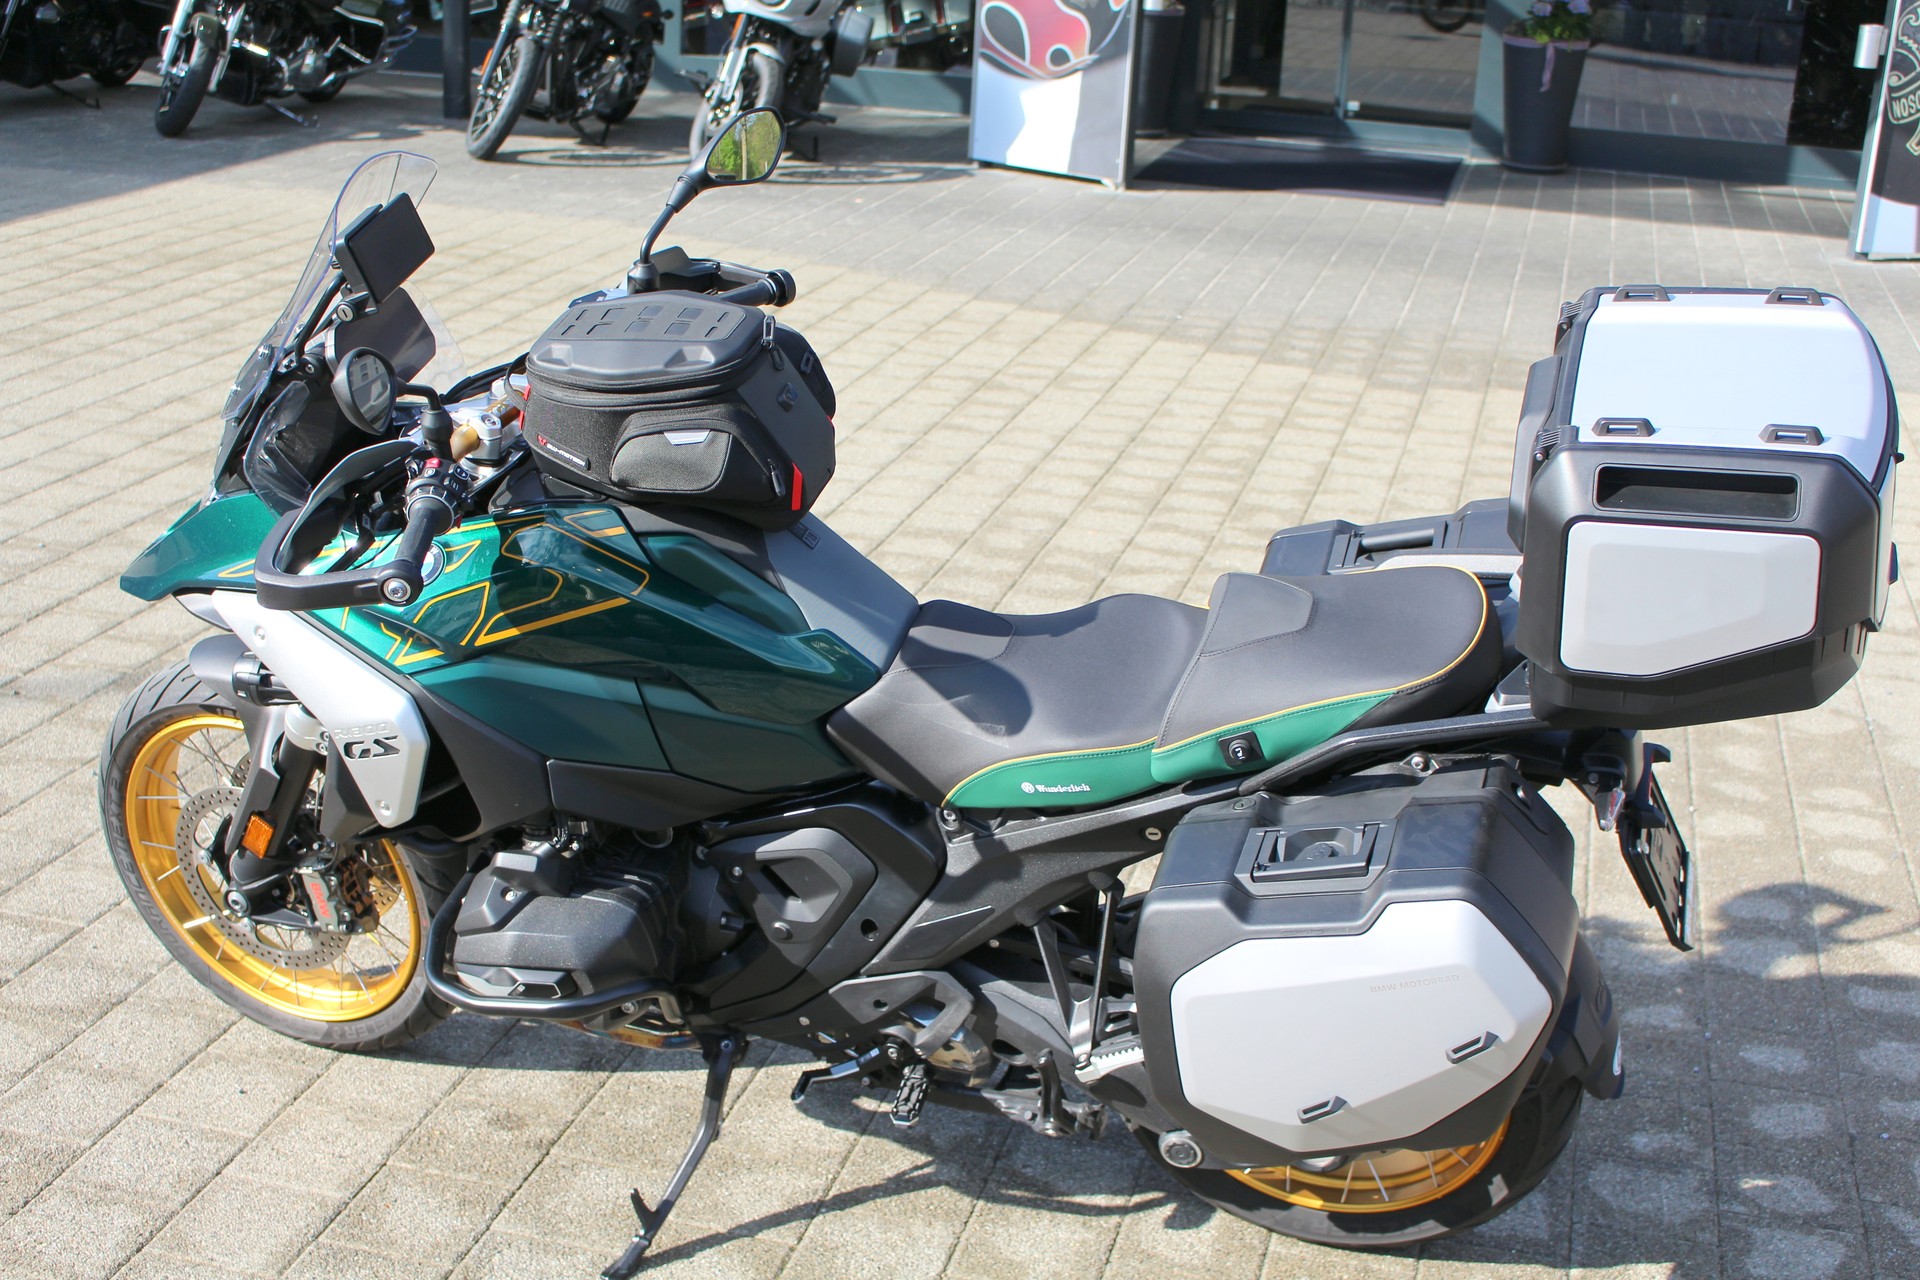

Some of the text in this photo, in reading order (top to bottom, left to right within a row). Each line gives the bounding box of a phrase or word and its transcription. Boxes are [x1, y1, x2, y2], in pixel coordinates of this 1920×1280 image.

[343, 735, 401, 760] GS
[1035, 783, 1091, 793] Wunderlich
[310, 882, 333, 919] BMW
